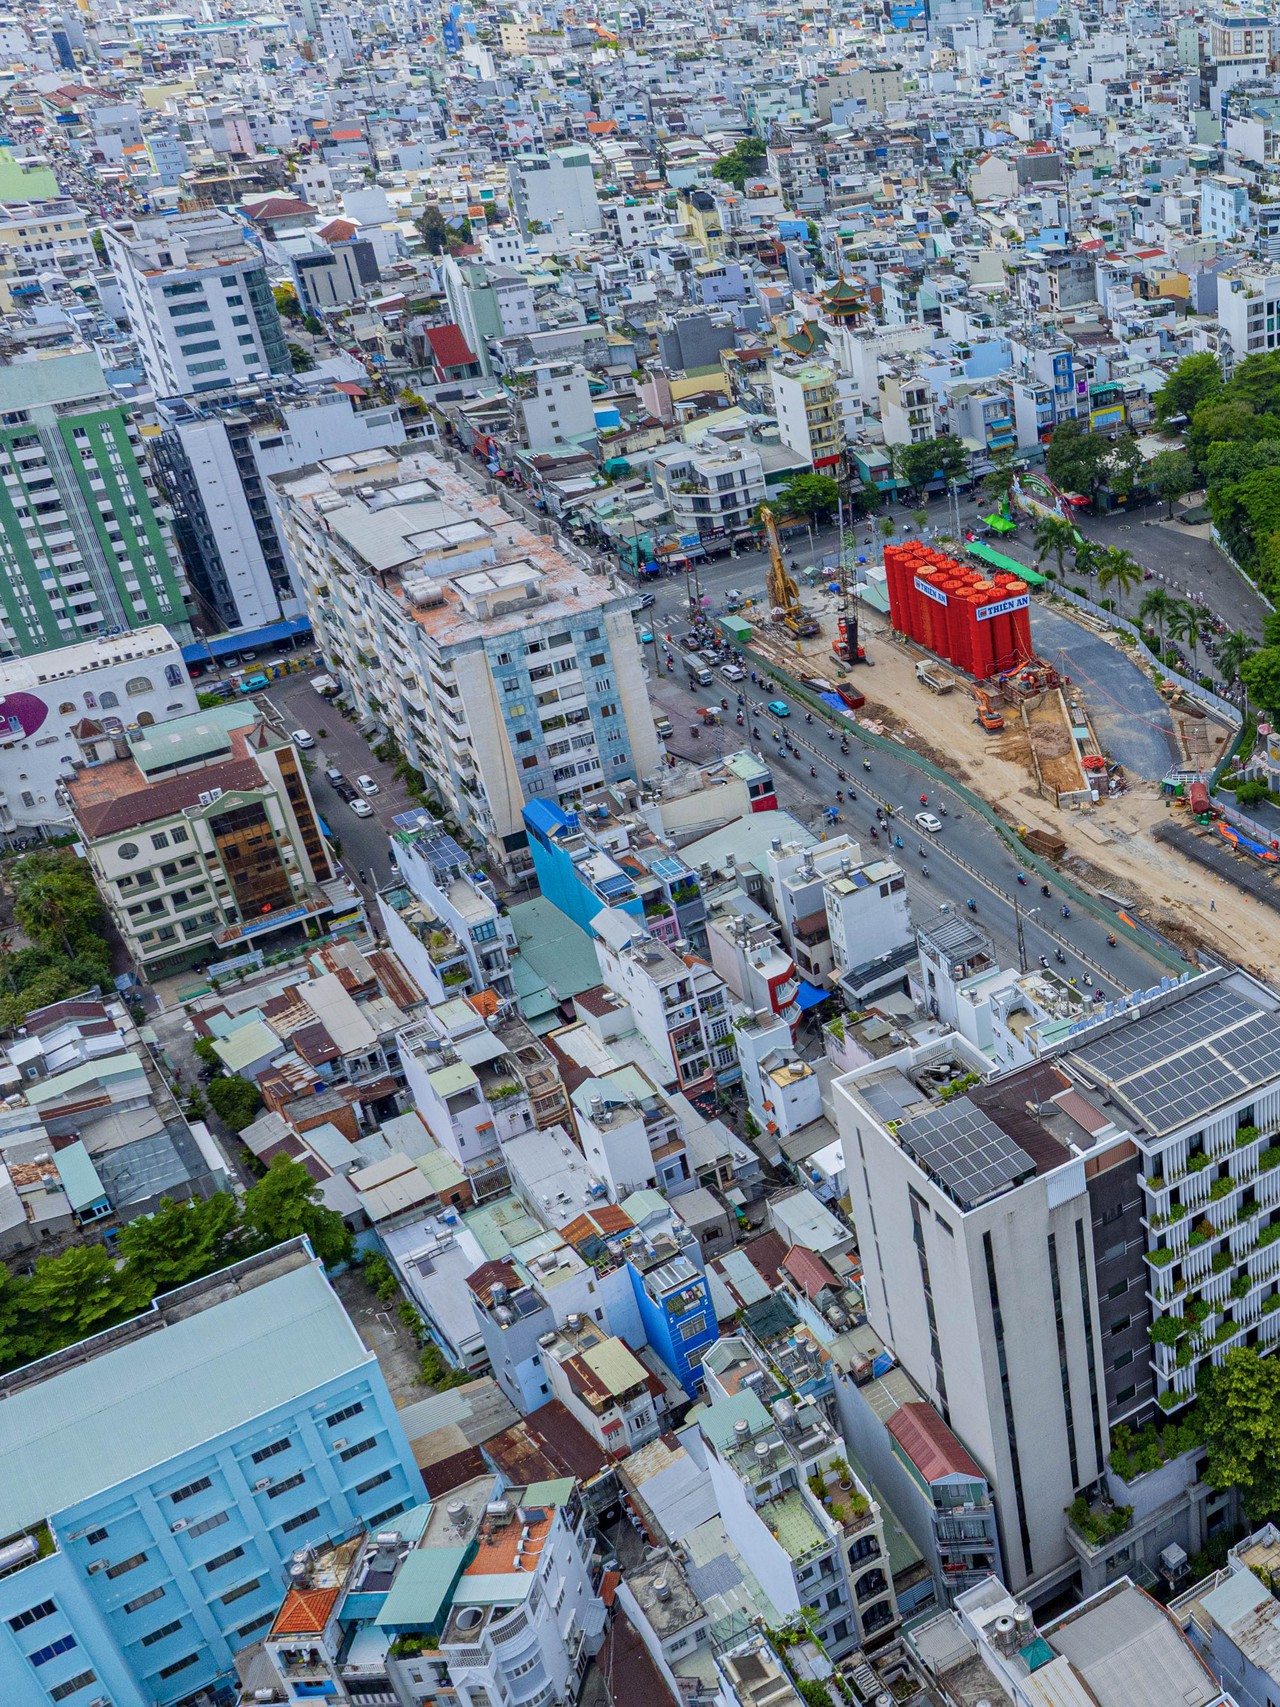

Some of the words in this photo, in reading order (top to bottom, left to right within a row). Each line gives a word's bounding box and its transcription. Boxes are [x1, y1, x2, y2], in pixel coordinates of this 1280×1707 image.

[921, 583, 936, 598] THIÊN
[988, 600, 1014, 615] THIÊN
[1016, 597, 1029, 608] AN
